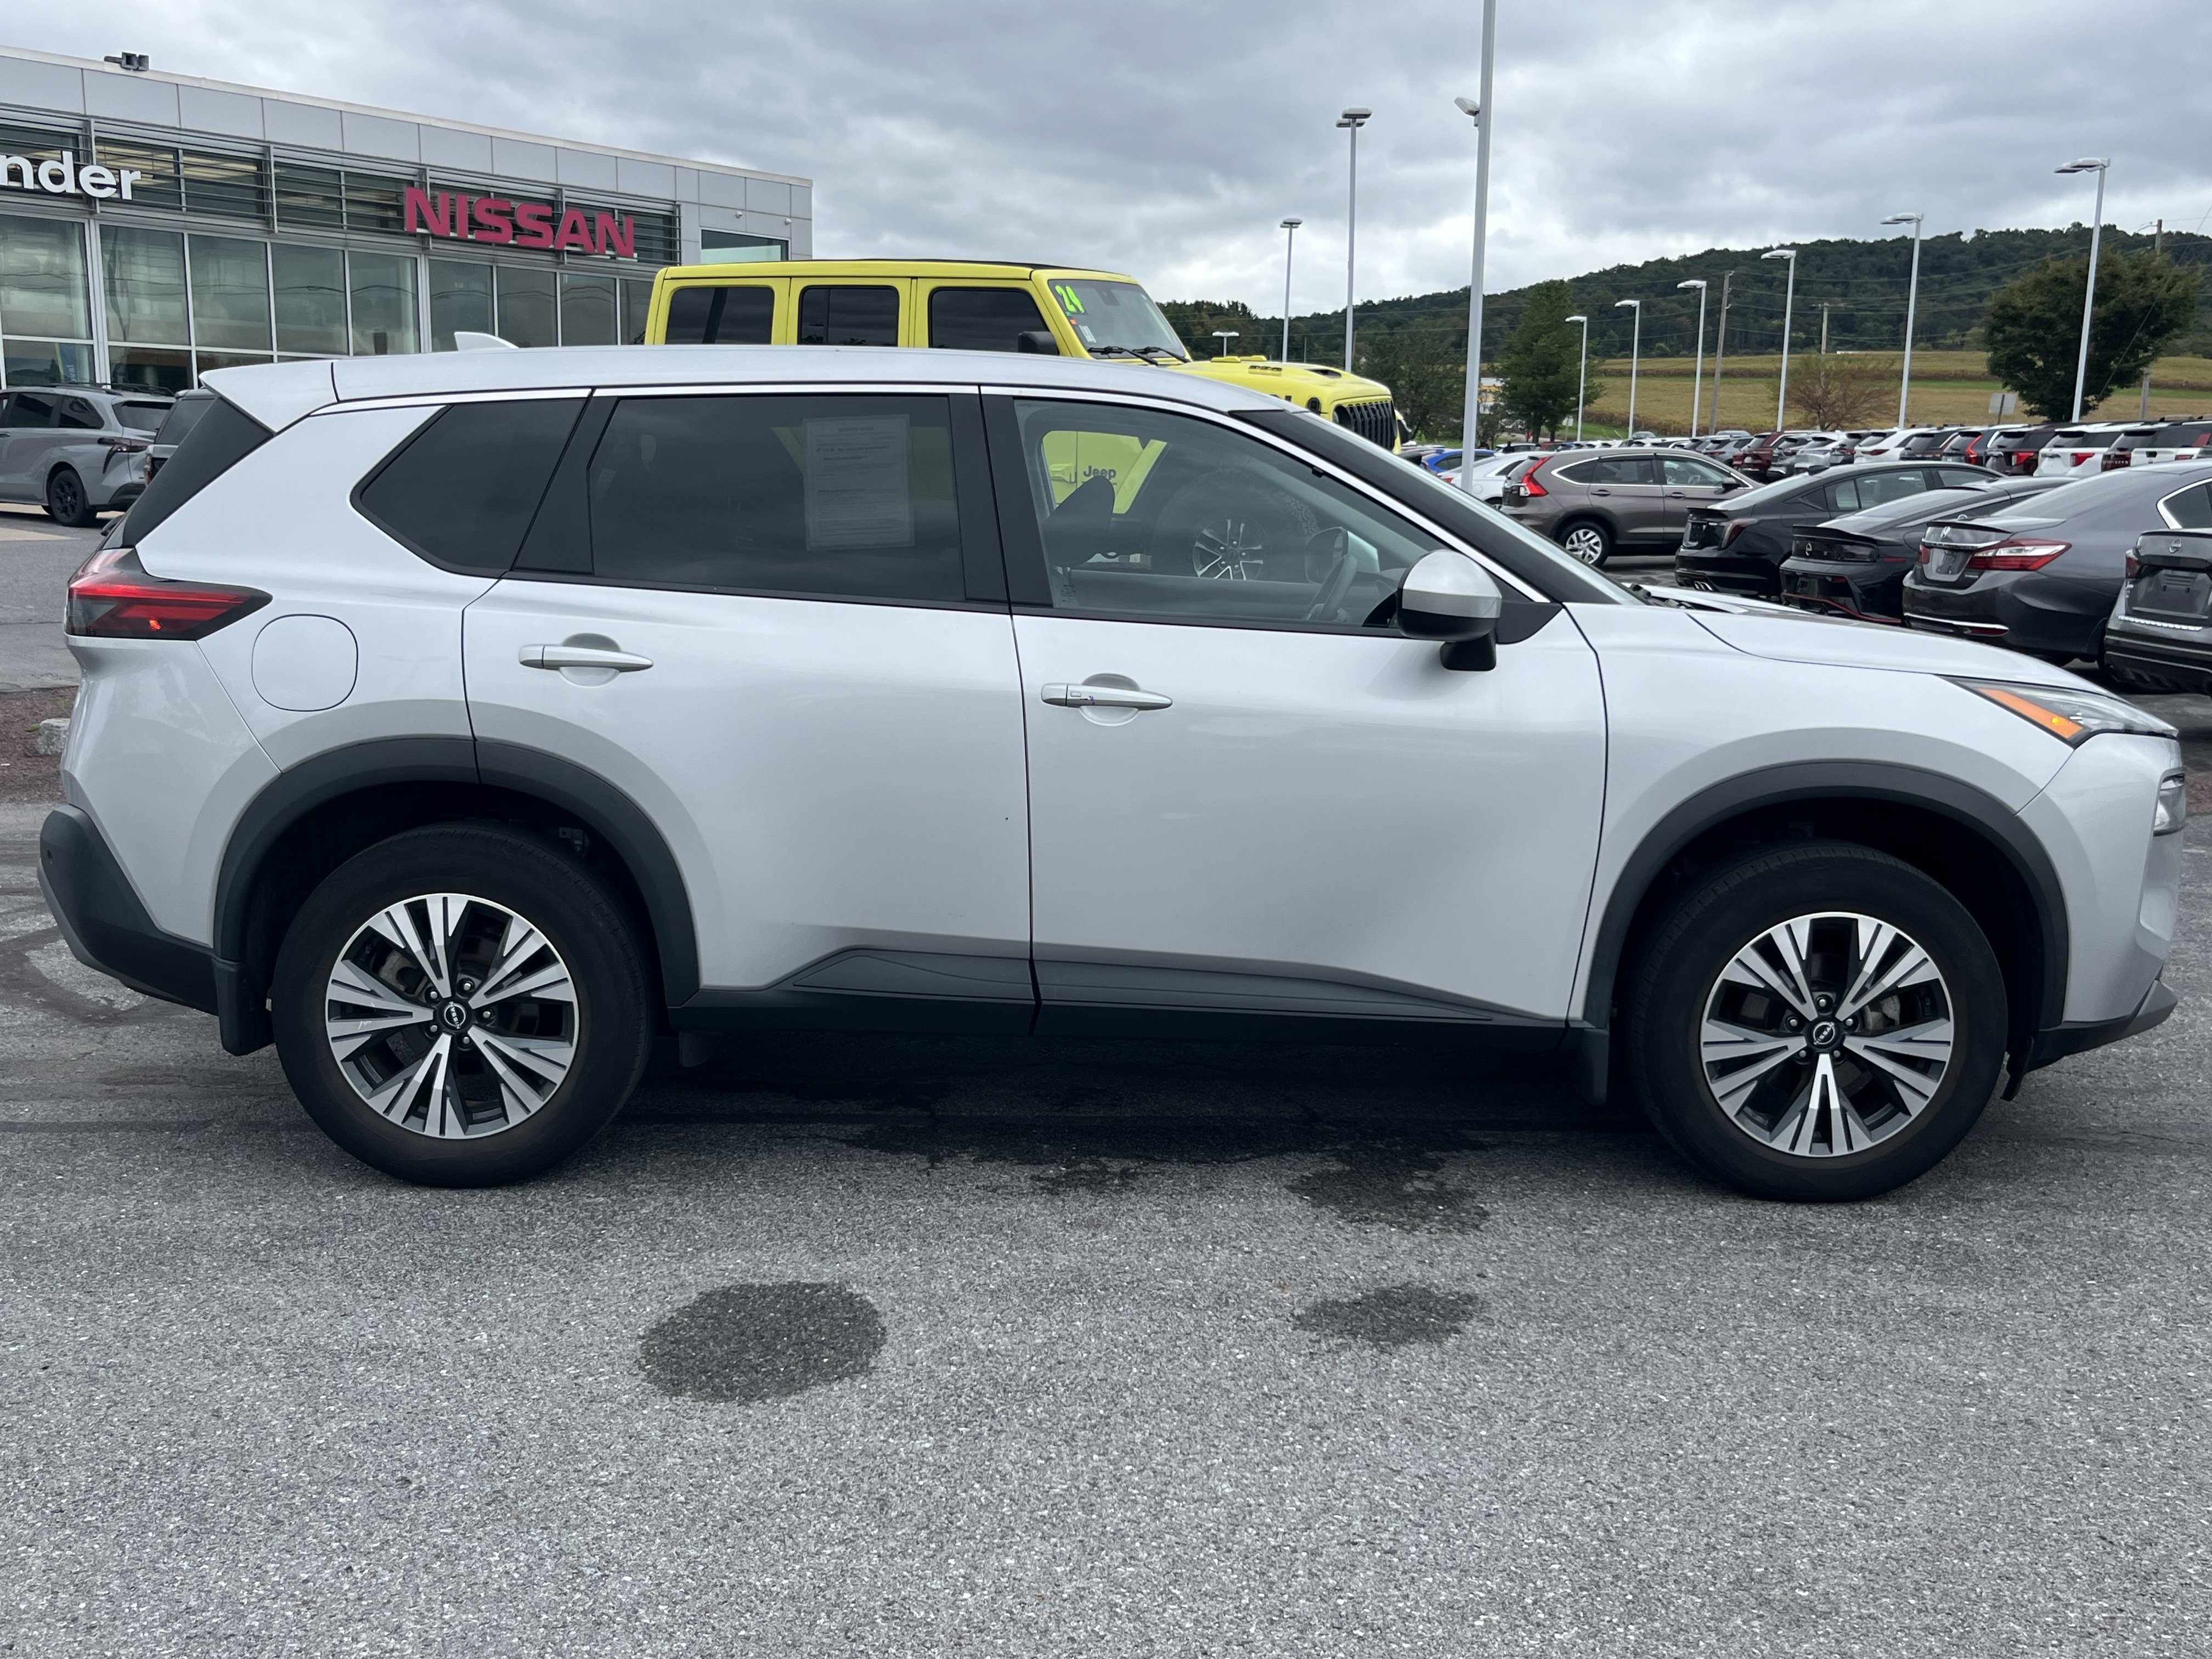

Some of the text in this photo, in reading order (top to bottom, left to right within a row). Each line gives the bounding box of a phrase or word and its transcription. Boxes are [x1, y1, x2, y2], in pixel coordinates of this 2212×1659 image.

[405, 187, 635, 257] NISSAN
[1054, 285, 1085, 314] 24
[1083, 465, 1116, 481] Jeep
[449, 1002, 460, 1029] NISSAN
[1813, 1022, 1835, 1046] NISSAN
